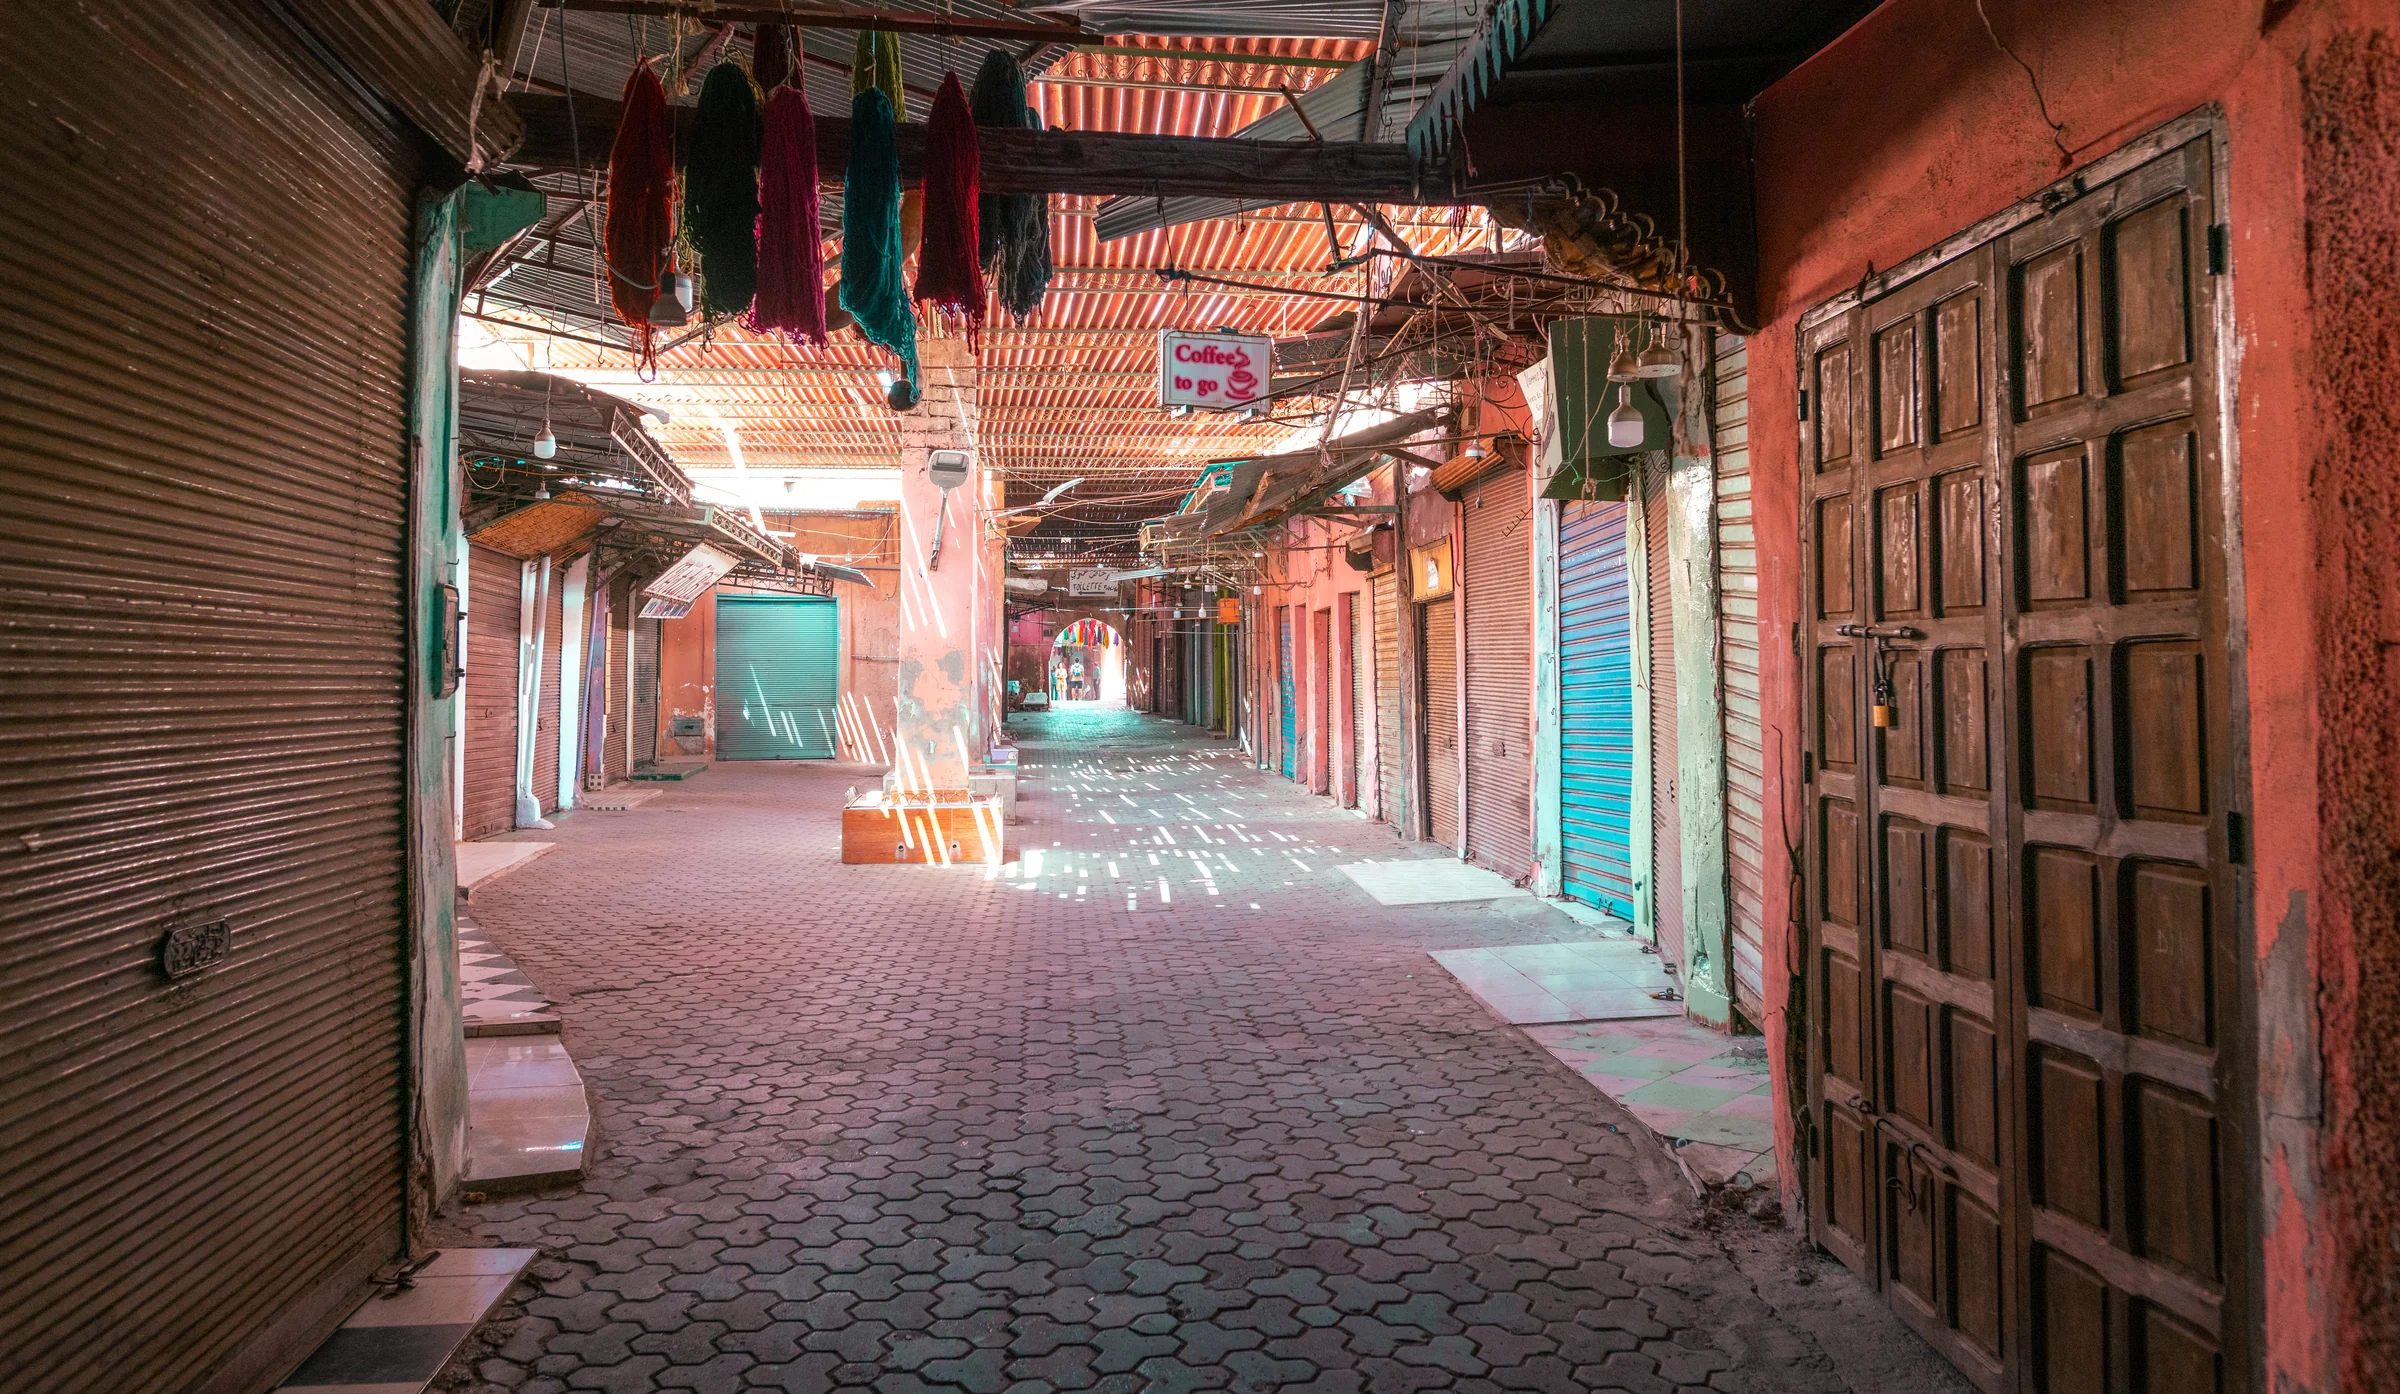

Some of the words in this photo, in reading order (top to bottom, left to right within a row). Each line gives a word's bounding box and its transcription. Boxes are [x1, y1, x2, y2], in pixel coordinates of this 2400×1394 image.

[1174, 344, 1235, 365] Coffee
[1174, 374, 1192, 391] to
[1196, 379, 1218, 397] go
